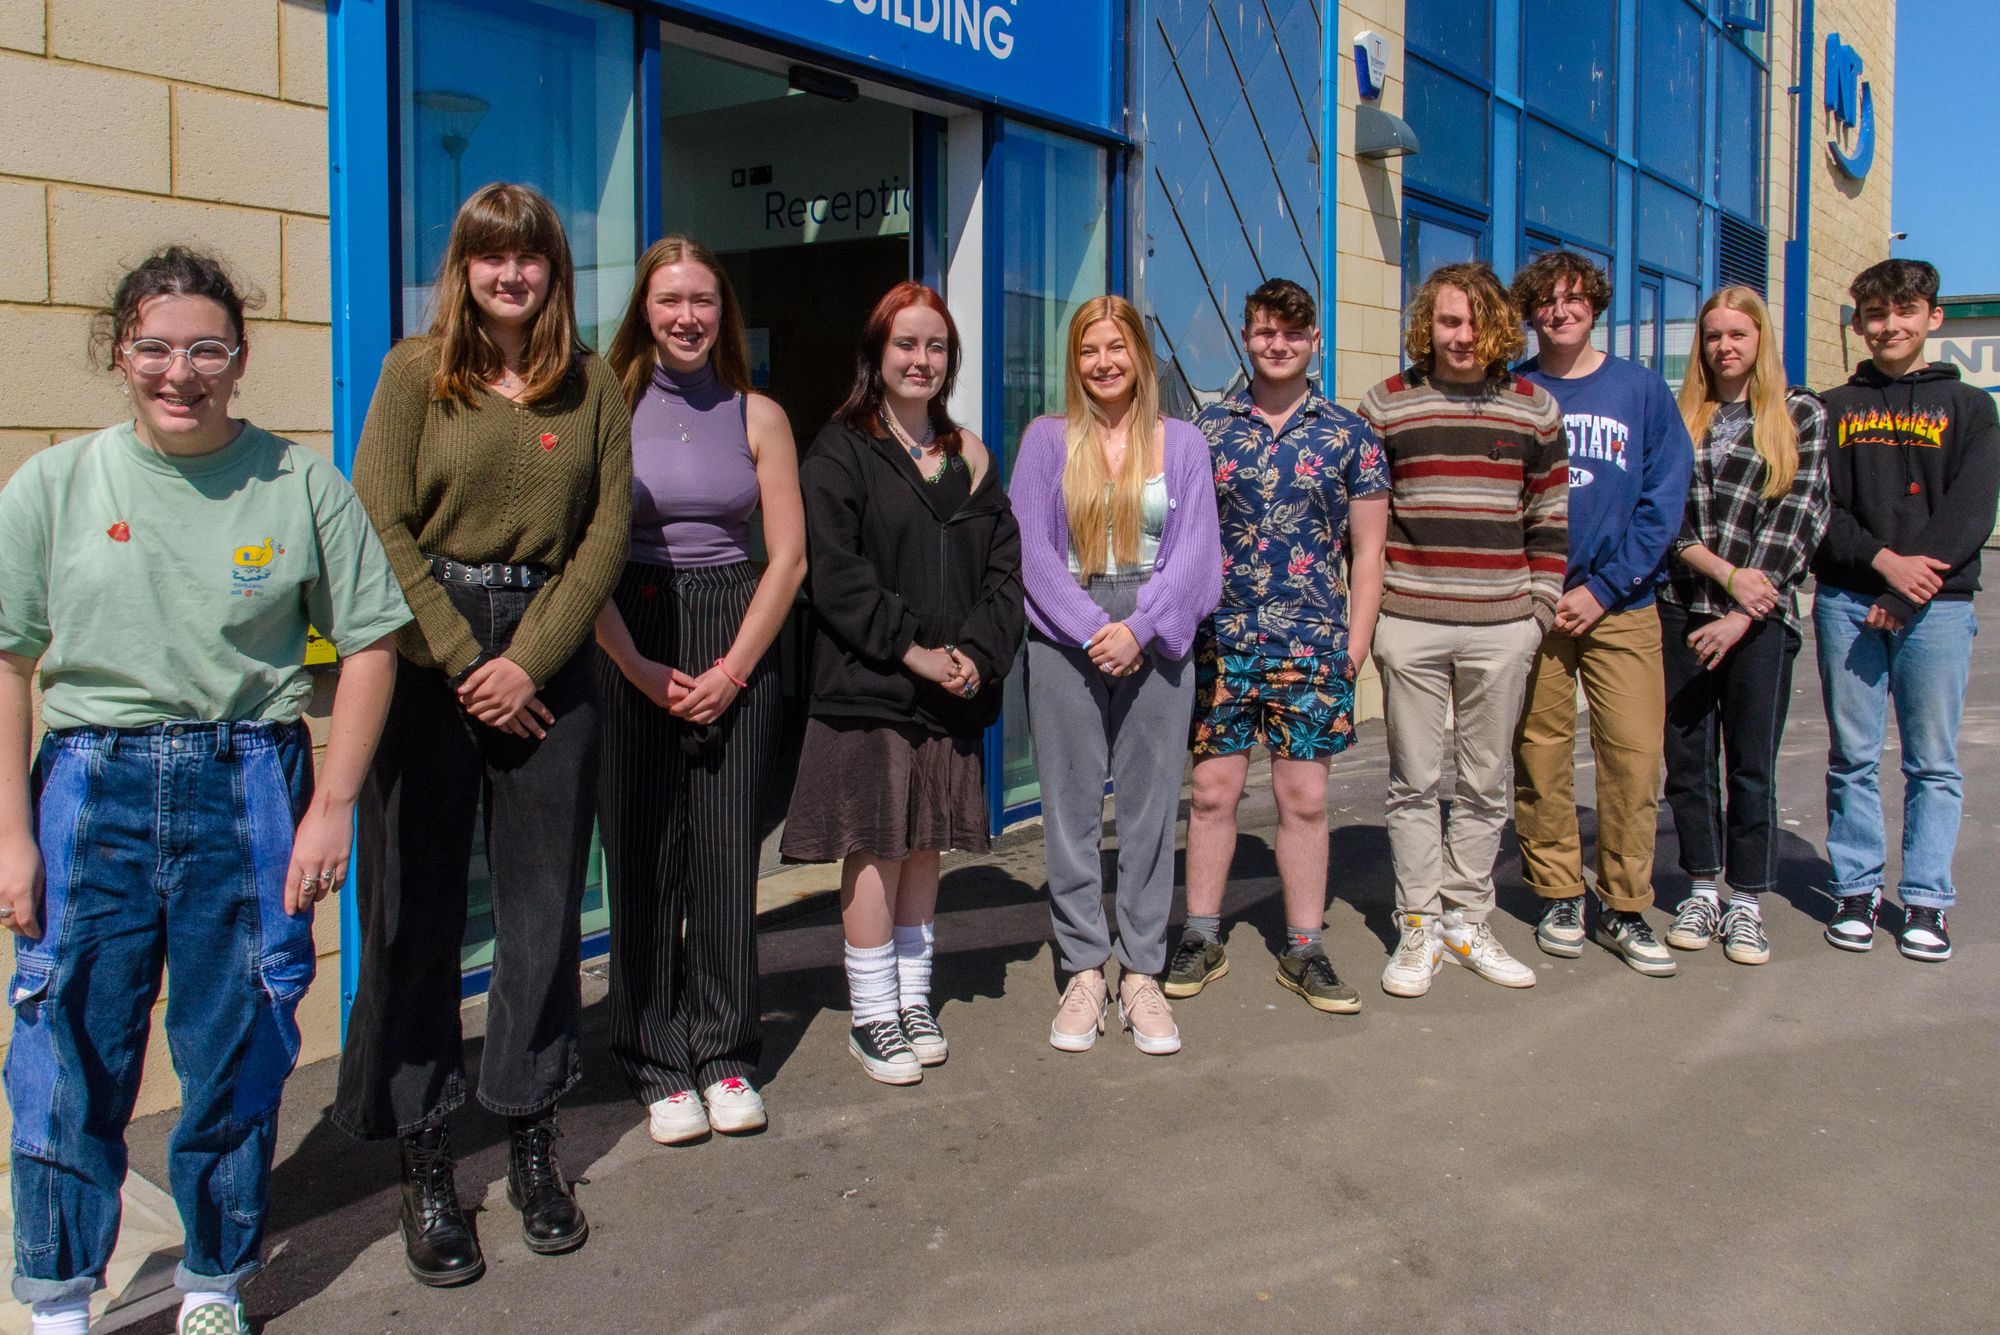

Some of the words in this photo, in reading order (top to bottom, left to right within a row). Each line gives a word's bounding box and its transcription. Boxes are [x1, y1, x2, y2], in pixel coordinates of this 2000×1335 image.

[827, 0, 1014, 59] LDING
[766, 175, 910, 230] Recepti
[1562, 413, 1629, 472] STATE
[1569, 471, 1582, 485] M
